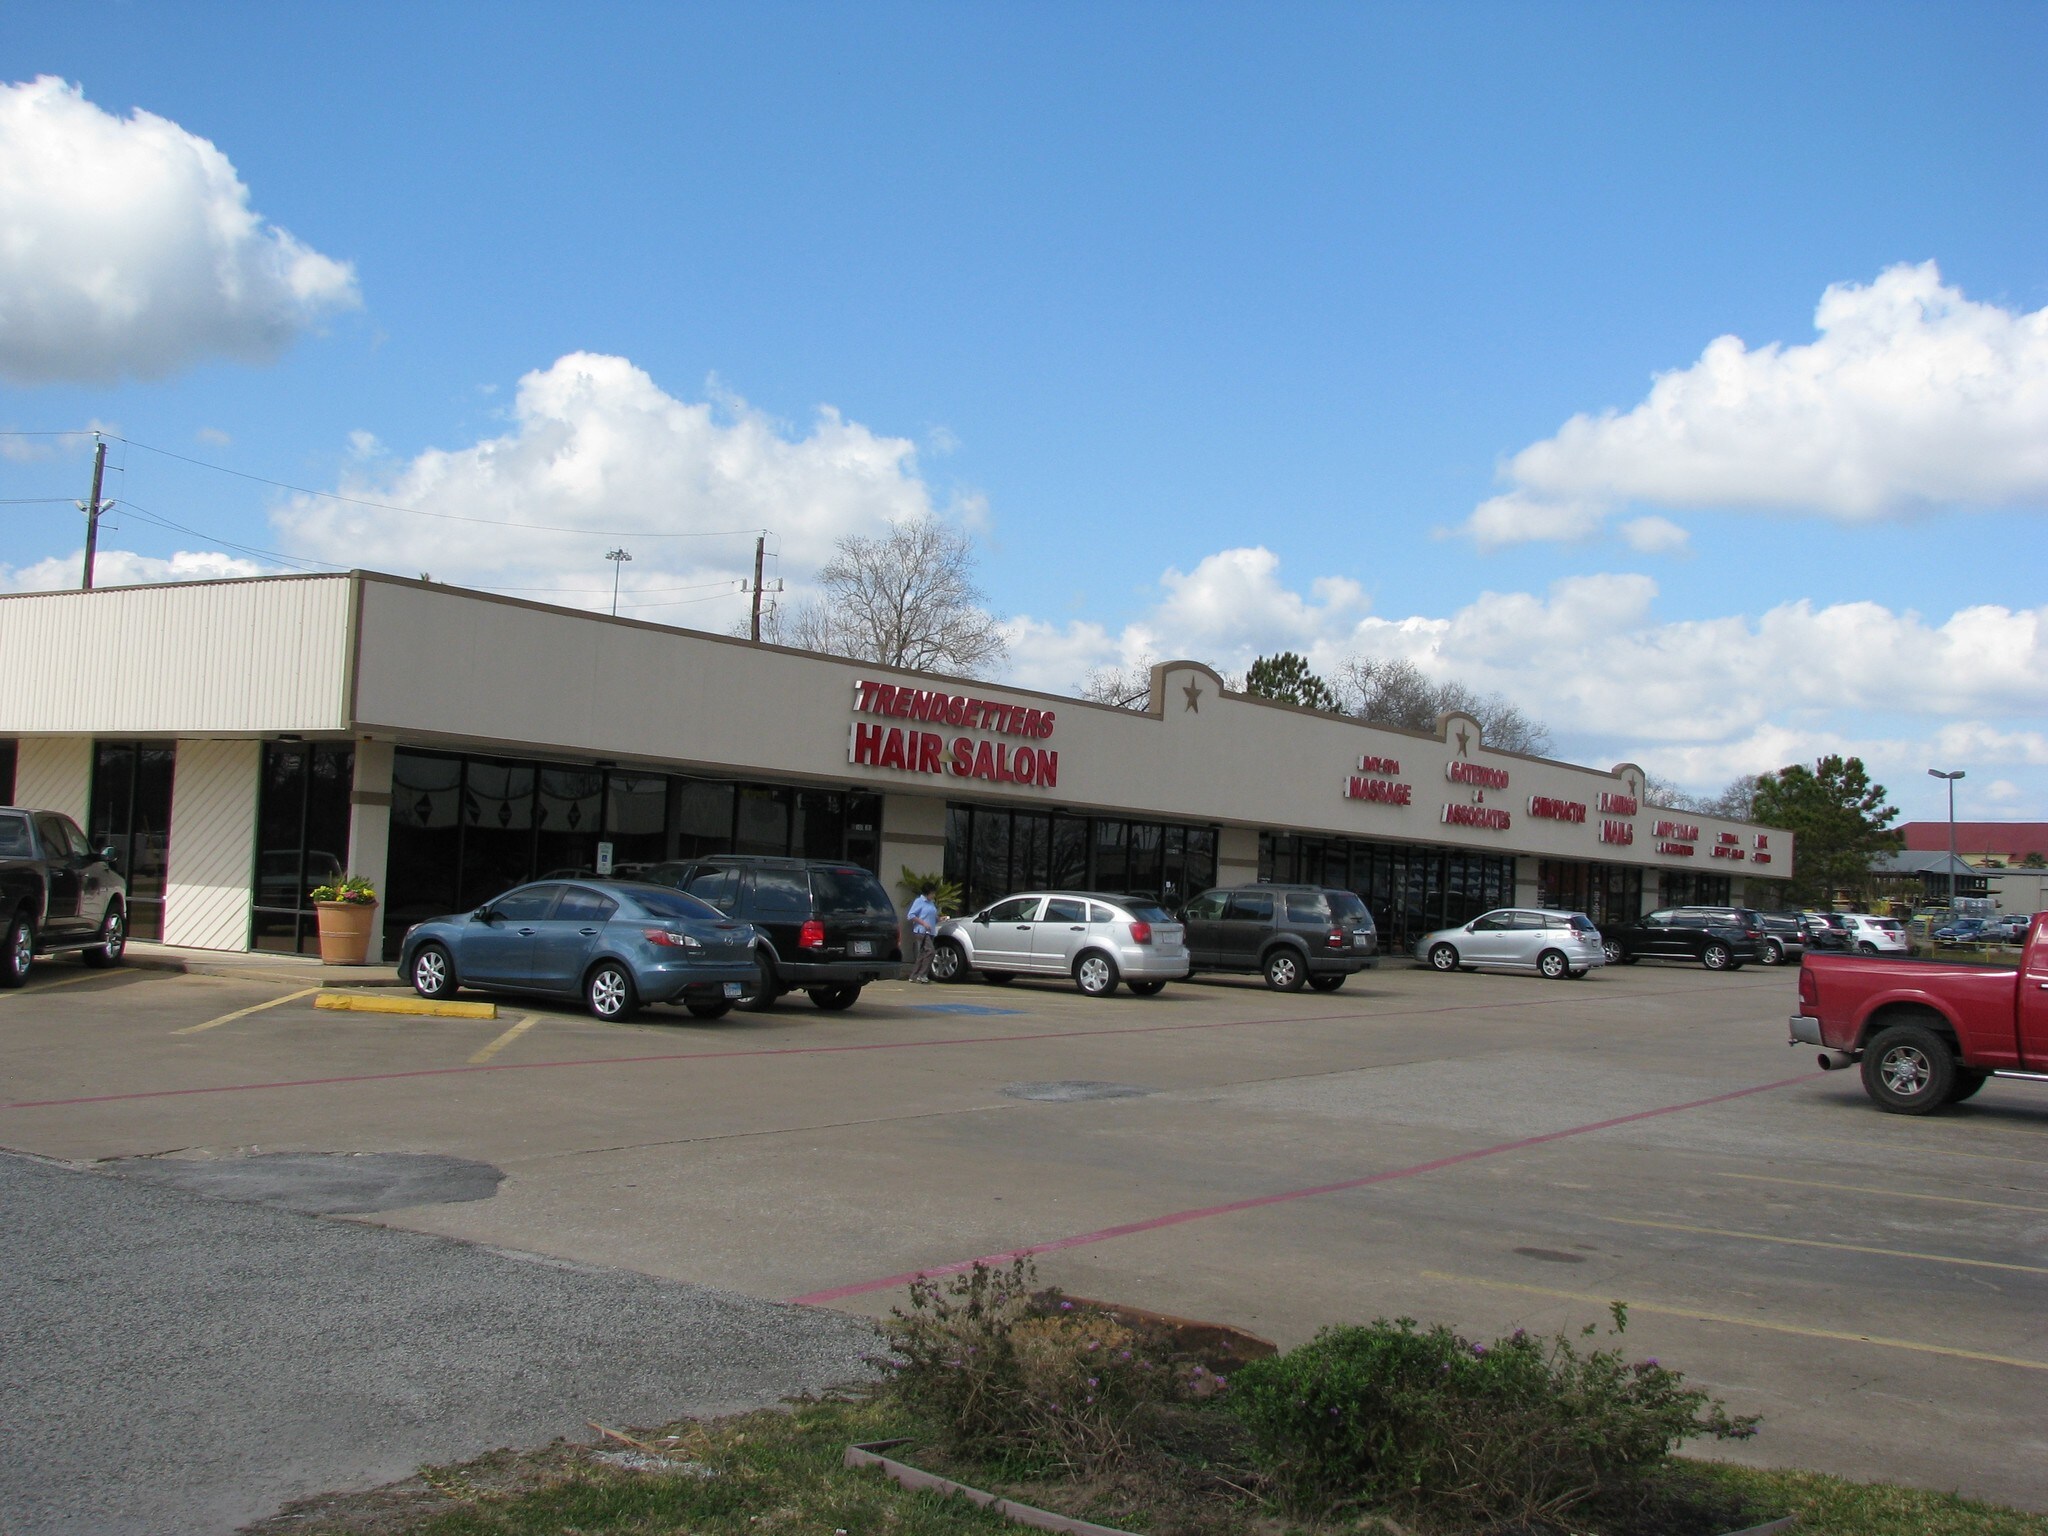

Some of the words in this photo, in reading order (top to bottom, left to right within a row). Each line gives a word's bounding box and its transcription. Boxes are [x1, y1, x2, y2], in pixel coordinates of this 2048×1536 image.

[853, 680, 1056, 739] TRENDSETTERS
[849, 722, 942, 774] HAIR
[947, 737, 1058, 788] SALON
[1446, 760, 1510, 789] GATEWOOD
[1344, 776, 1412, 806] MASSAGE
[1473, 789, 1484, 804] &
[1441, 803, 1511, 830] ASSOCIATES
[1527, 795, 1587, 824] CHIROPRACTOR
[1600, 819, 1634, 846] NAILS
